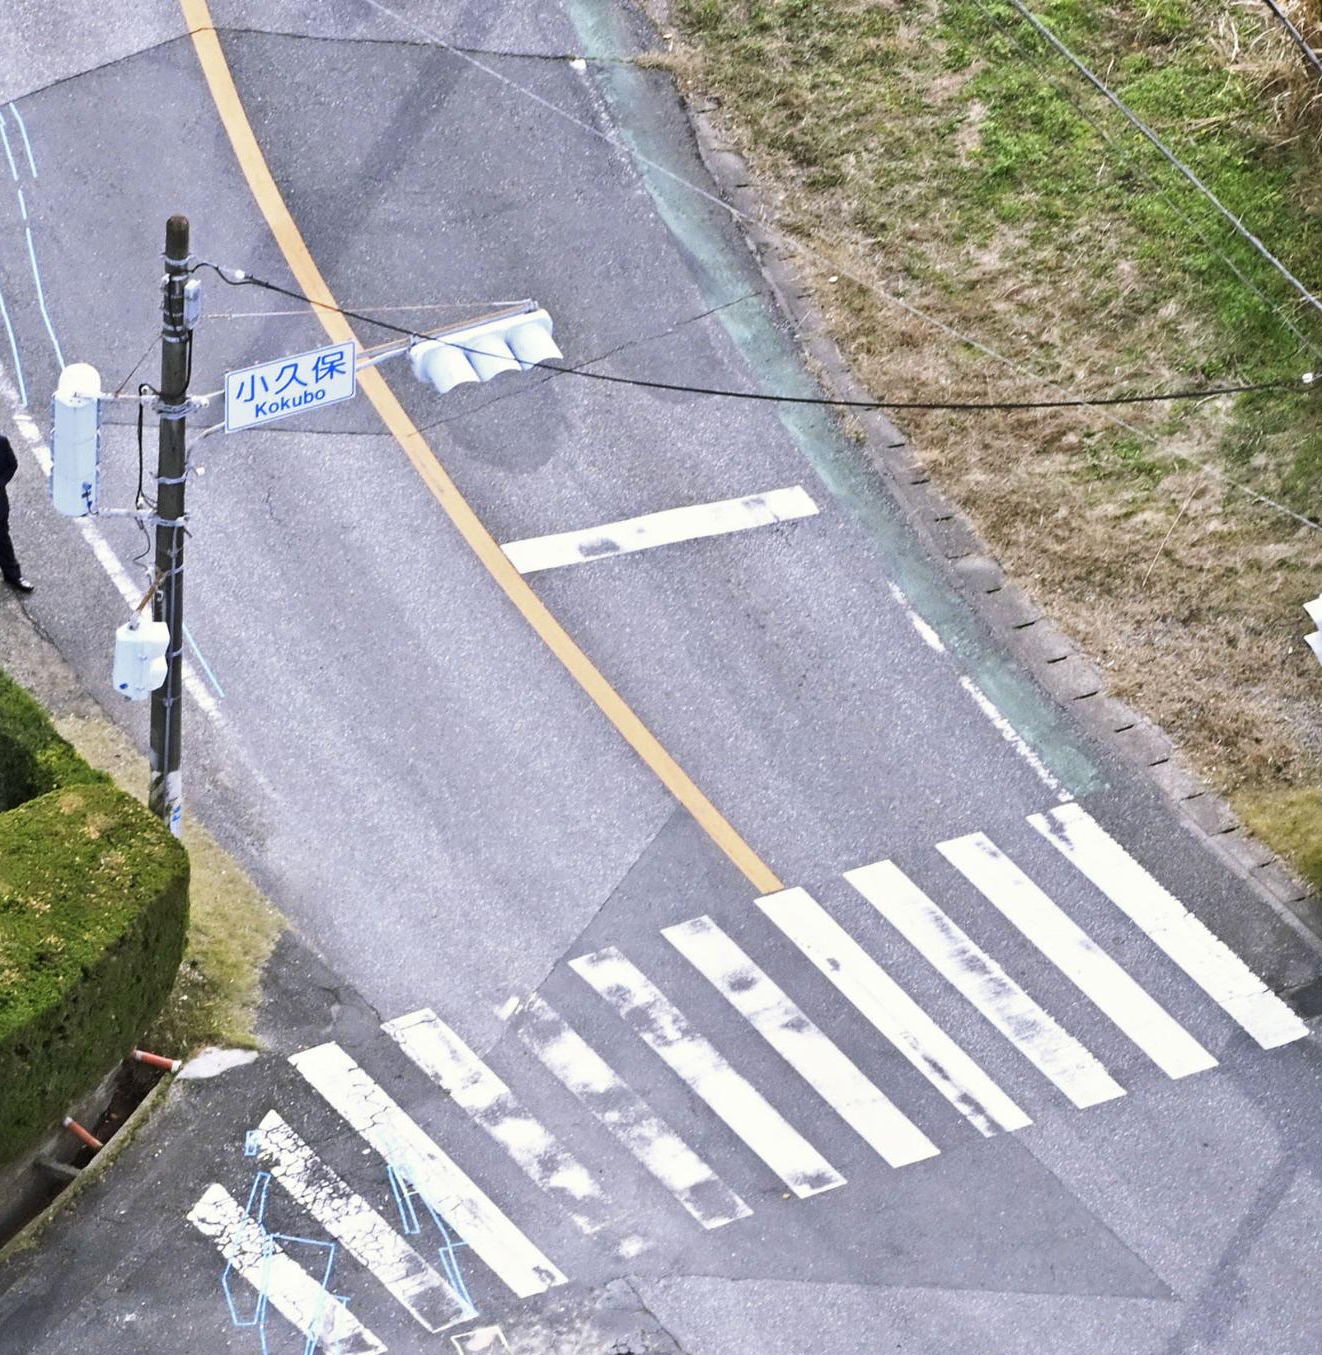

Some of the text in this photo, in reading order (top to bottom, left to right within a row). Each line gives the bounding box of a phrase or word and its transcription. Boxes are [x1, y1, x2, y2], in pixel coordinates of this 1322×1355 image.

[235, 350, 347, 404] 小久保
[255, 388, 327, 418] Kokubo
